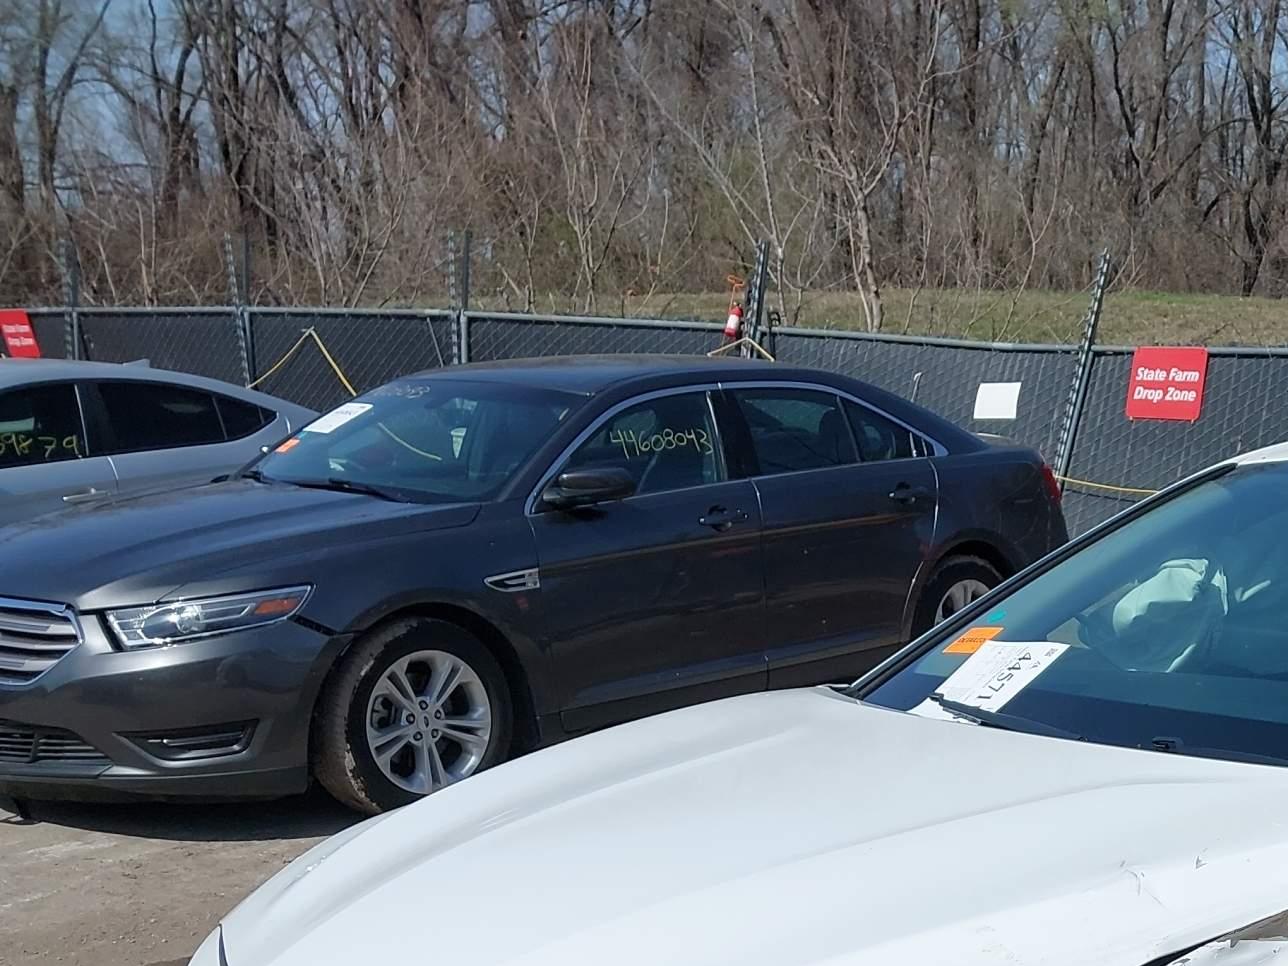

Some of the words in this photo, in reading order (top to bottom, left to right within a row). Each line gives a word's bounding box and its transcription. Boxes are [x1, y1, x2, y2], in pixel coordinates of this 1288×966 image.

[1135, 367, 1167, 381] State
[1168, 367, 1200, 382] Farm
[1133, 386, 1164, 403] Drop
[1164, 387, 1197, 402] Zone
[609, 428, 714, 460] 44608043
